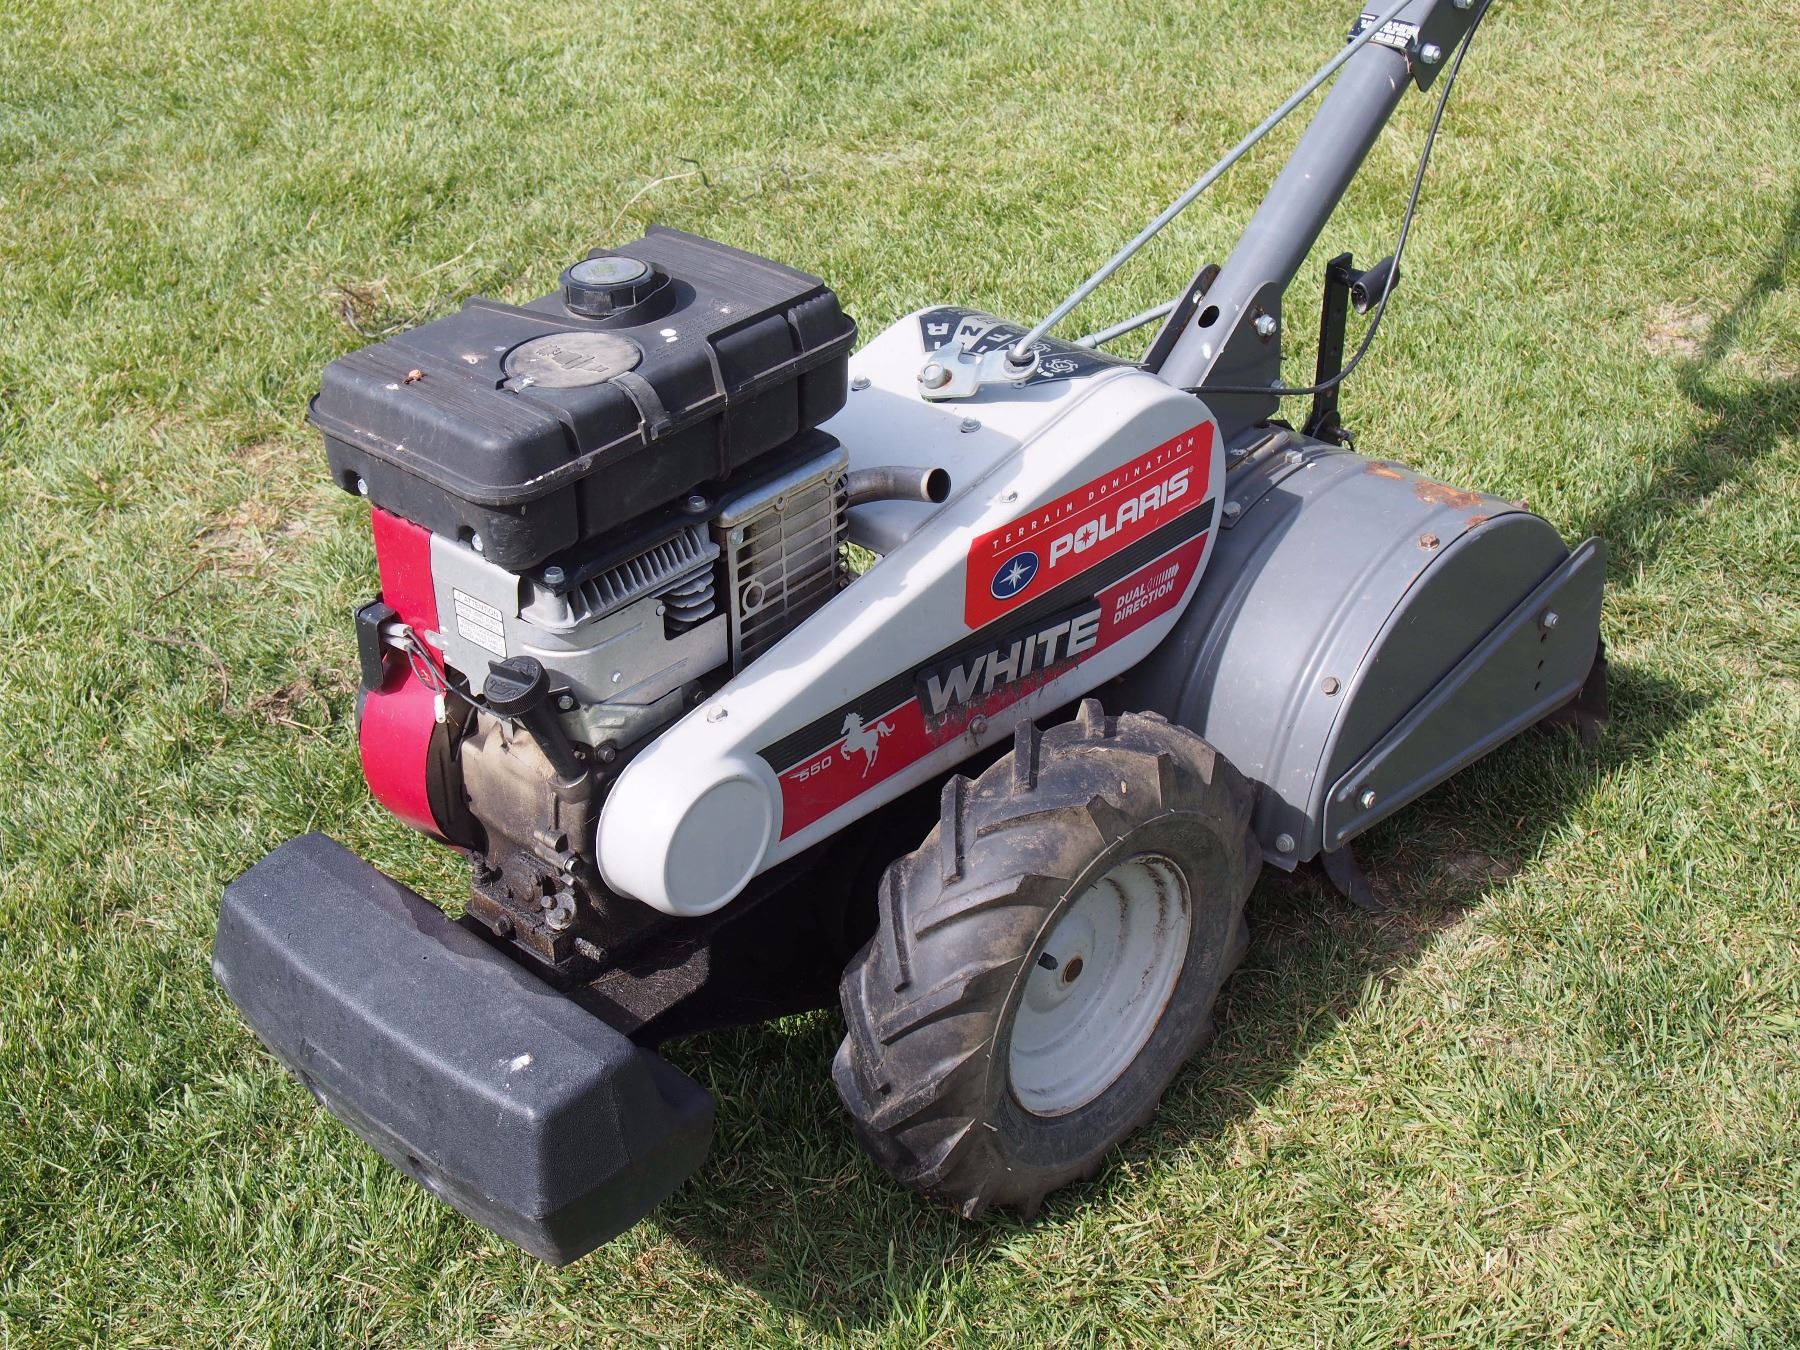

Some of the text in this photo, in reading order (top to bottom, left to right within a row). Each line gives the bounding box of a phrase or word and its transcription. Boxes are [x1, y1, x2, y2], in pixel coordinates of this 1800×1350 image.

[992, 436, 1194, 550] TERRAIN DOMINATION
[1049, 466, 1190, 569] POLARIS
[463, 596, 500, 618] ATTENTION
[1112, 578, 1175, 625] DIRECTION
[1115, 582, 1146, 609] DUAL
[926, 607, 1103, 716] WHITE
[789, 755, 832, 782] 550
